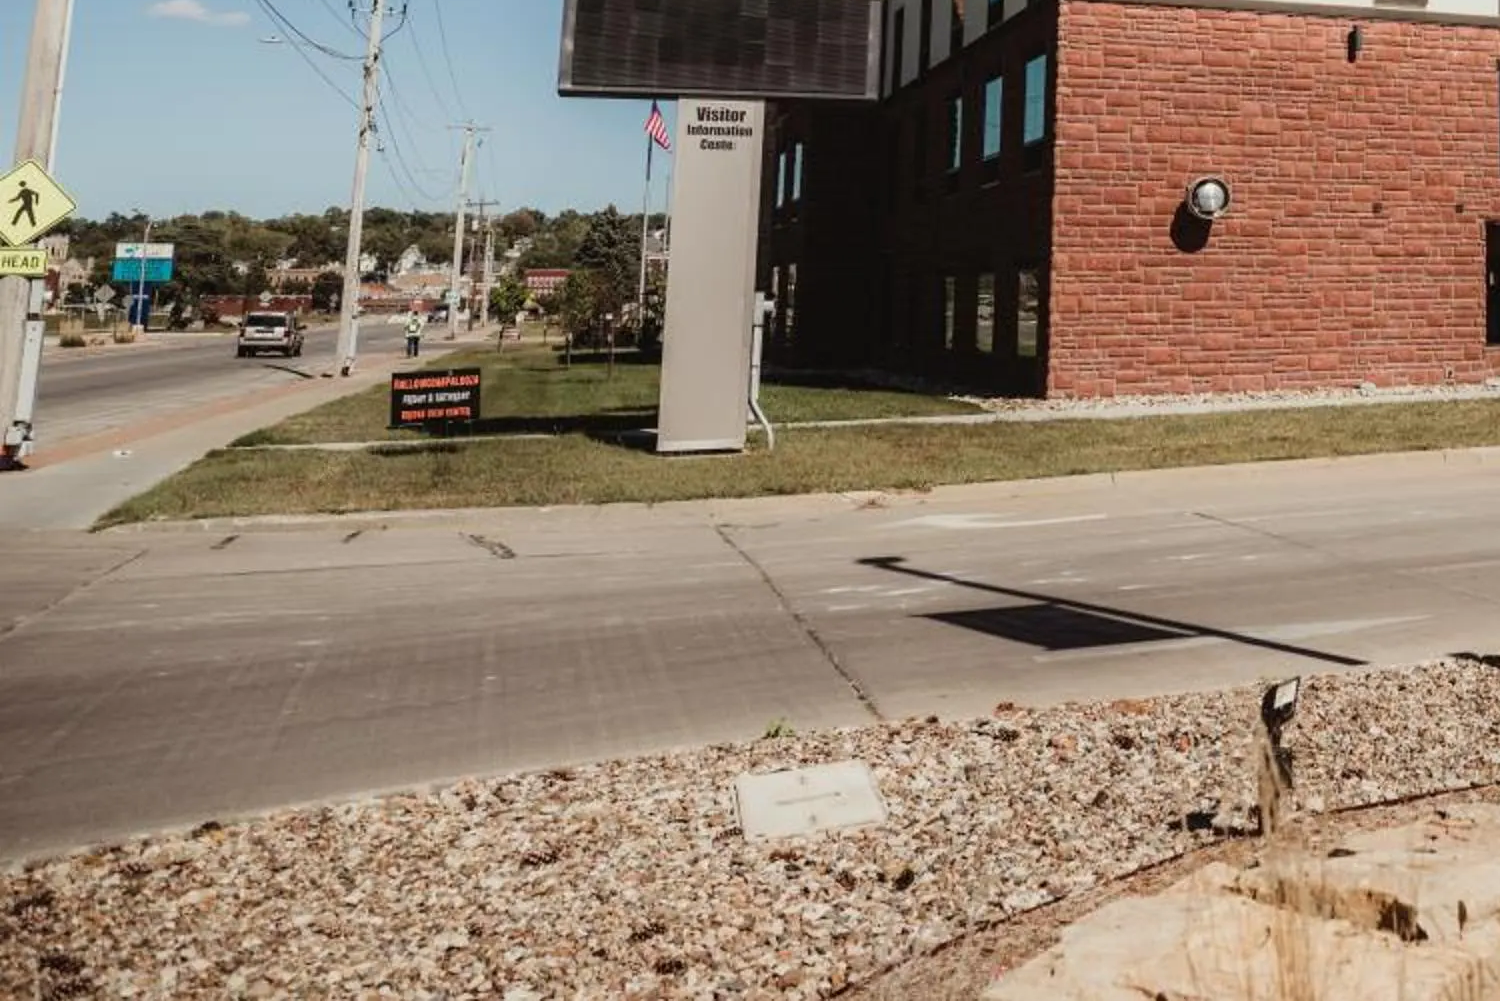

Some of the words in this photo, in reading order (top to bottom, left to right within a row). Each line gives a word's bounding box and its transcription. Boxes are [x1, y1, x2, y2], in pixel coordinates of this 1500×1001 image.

[696, 105, 748, 122] Visitor
[687, 124, 753, 137] Information
[1, 255, 40, 268] HEAD
